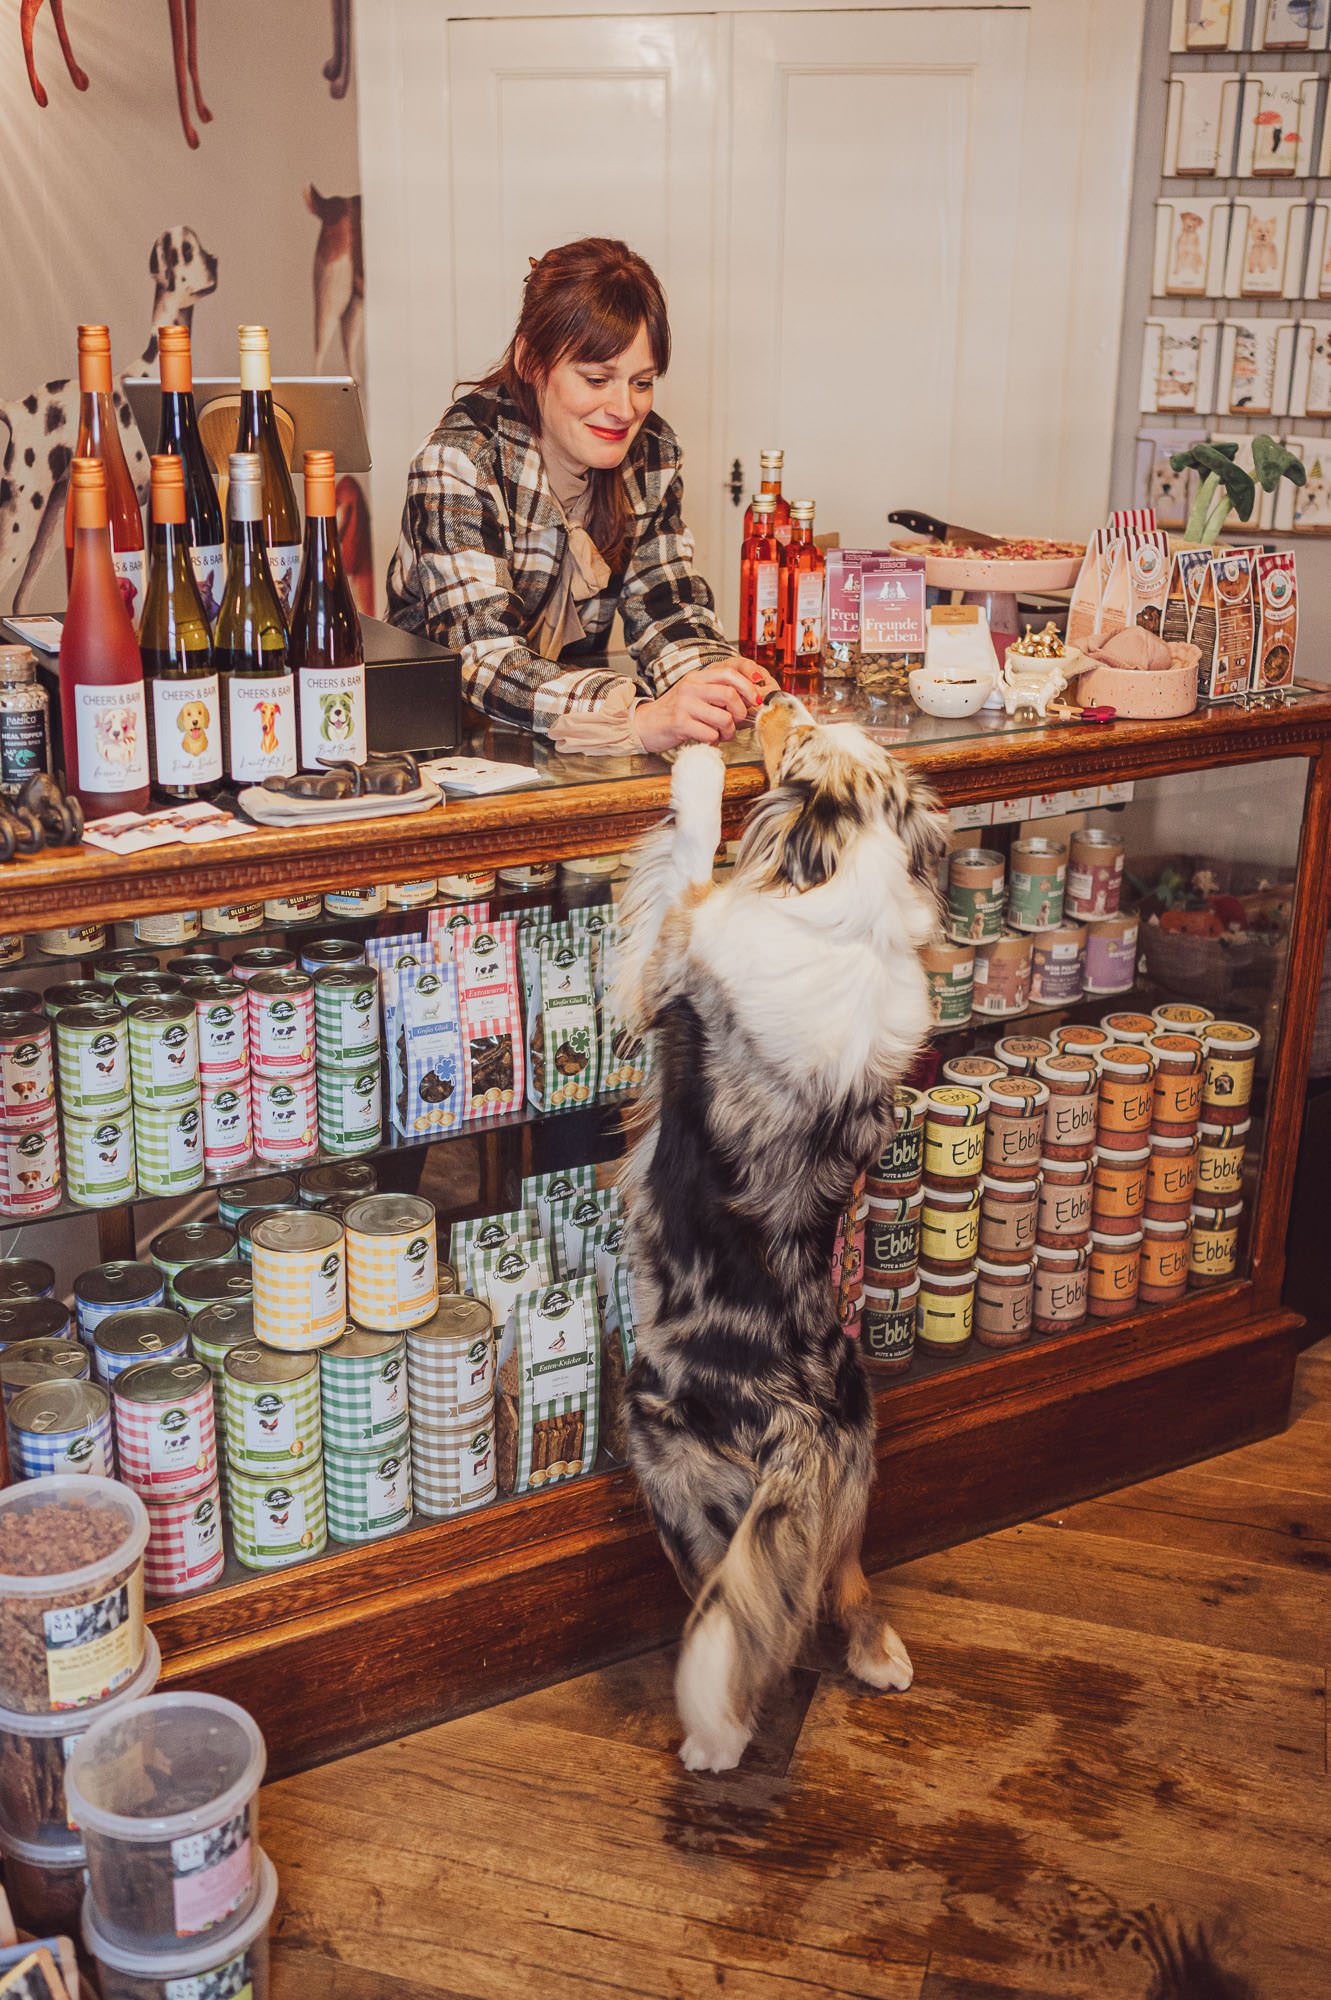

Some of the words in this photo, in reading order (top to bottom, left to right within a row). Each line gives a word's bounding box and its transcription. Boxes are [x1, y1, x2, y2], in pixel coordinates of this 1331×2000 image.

[831, 608, 859, 620] Freu
[865, 617, 918, 630] Freunde
[162, 690, 195, 701] CHEERS
[196, 688, 201, 699] &
[237, 688, 269, 699] CHEERS
[271, 687, 277, 697] &
[307, 678, 339, 689] CHEERS
[340, 677, 346, 687] &
[83, 695, 117, 706] CHEERS
[119, 695, 124, 704] &
[231, 907, 245, 916] BLUE
[289, 896, 304, 904] BLUE
[1123, 1092, 1152, 1122] Ebb
[1175, 1084, 1201, 1112] Ebb
[1056, 1103, 1093, 1134] Ebbi
[879, 1137, 918, 1170] Ebbi
[952, 1134, 983, 1166] Ebb
[1164, 1166, 1193, 1193] Ebb
[1056, 1192, 1091, 1224] Ebbi
[874, 1228, 914, 1261] Ebbi
[1160, 1249, 1186, 1277] Ebb
[1051, 1278, 1086, 1310] Ebbi
[870, 1318, 909, 1348] Ebbi
